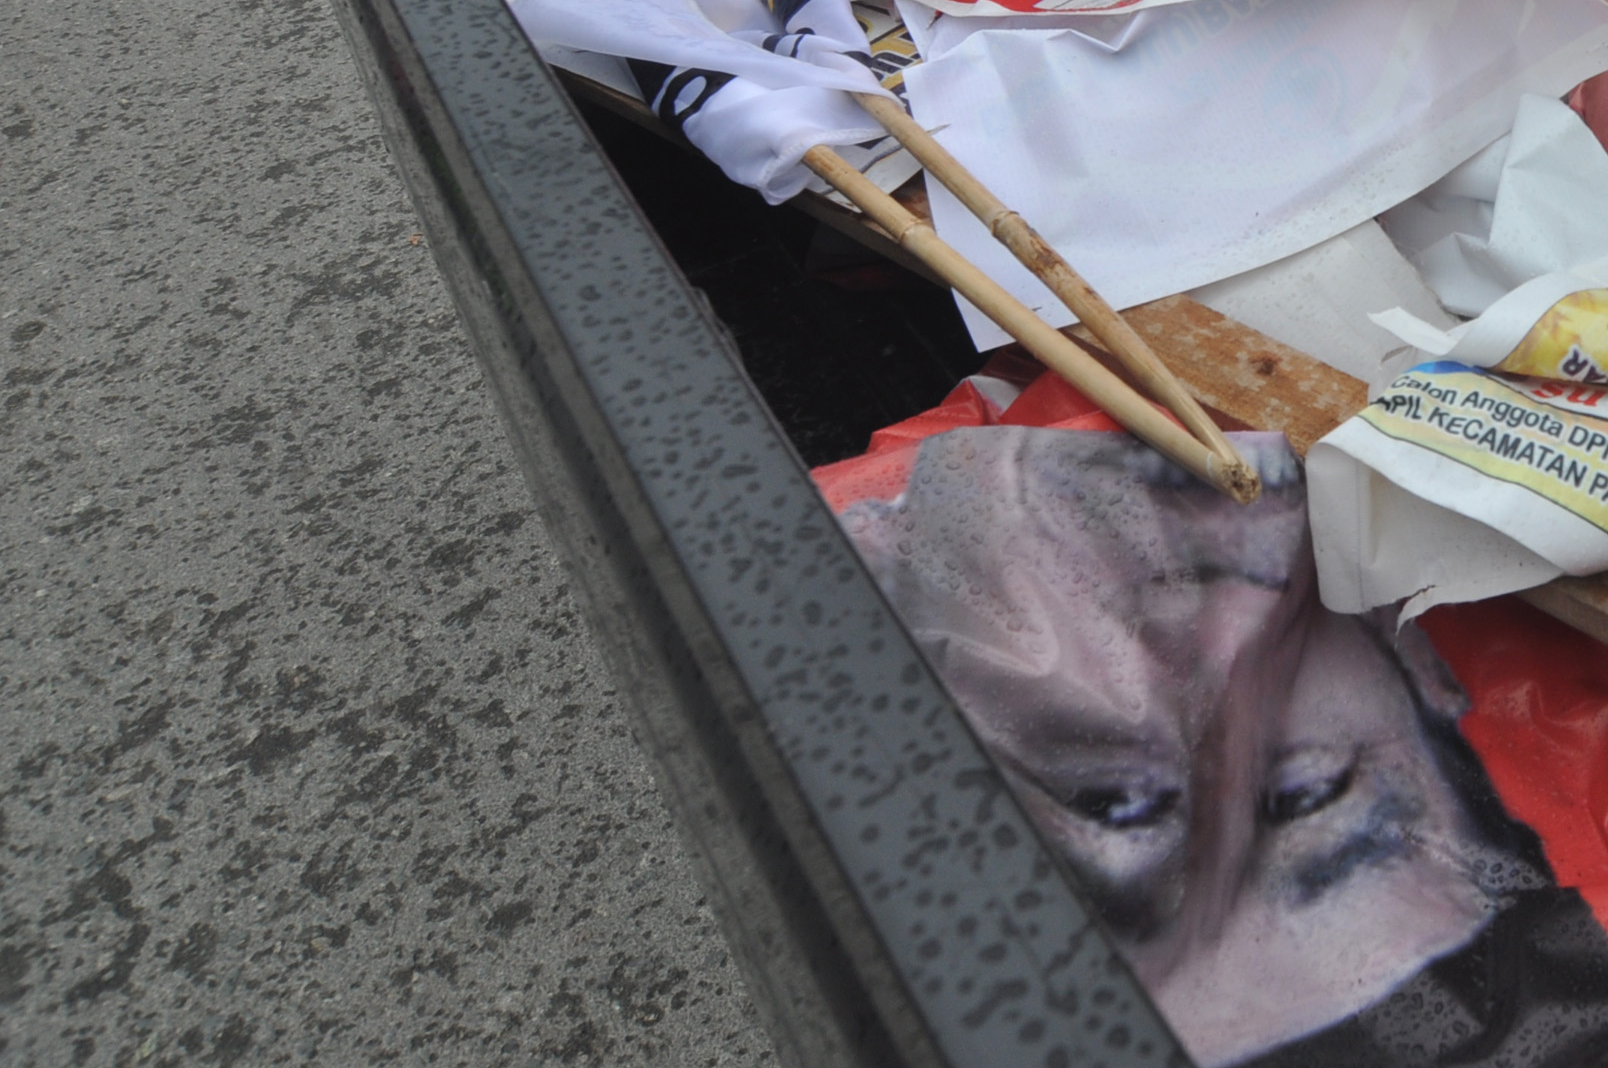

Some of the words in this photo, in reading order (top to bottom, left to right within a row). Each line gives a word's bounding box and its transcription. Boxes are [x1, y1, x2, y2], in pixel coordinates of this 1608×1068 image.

[1390, 375, 1458, 406] Calon
[1461, 390, 1564, 438] Anggota
[1426, 406, 1586, 487] KECAMATAN
